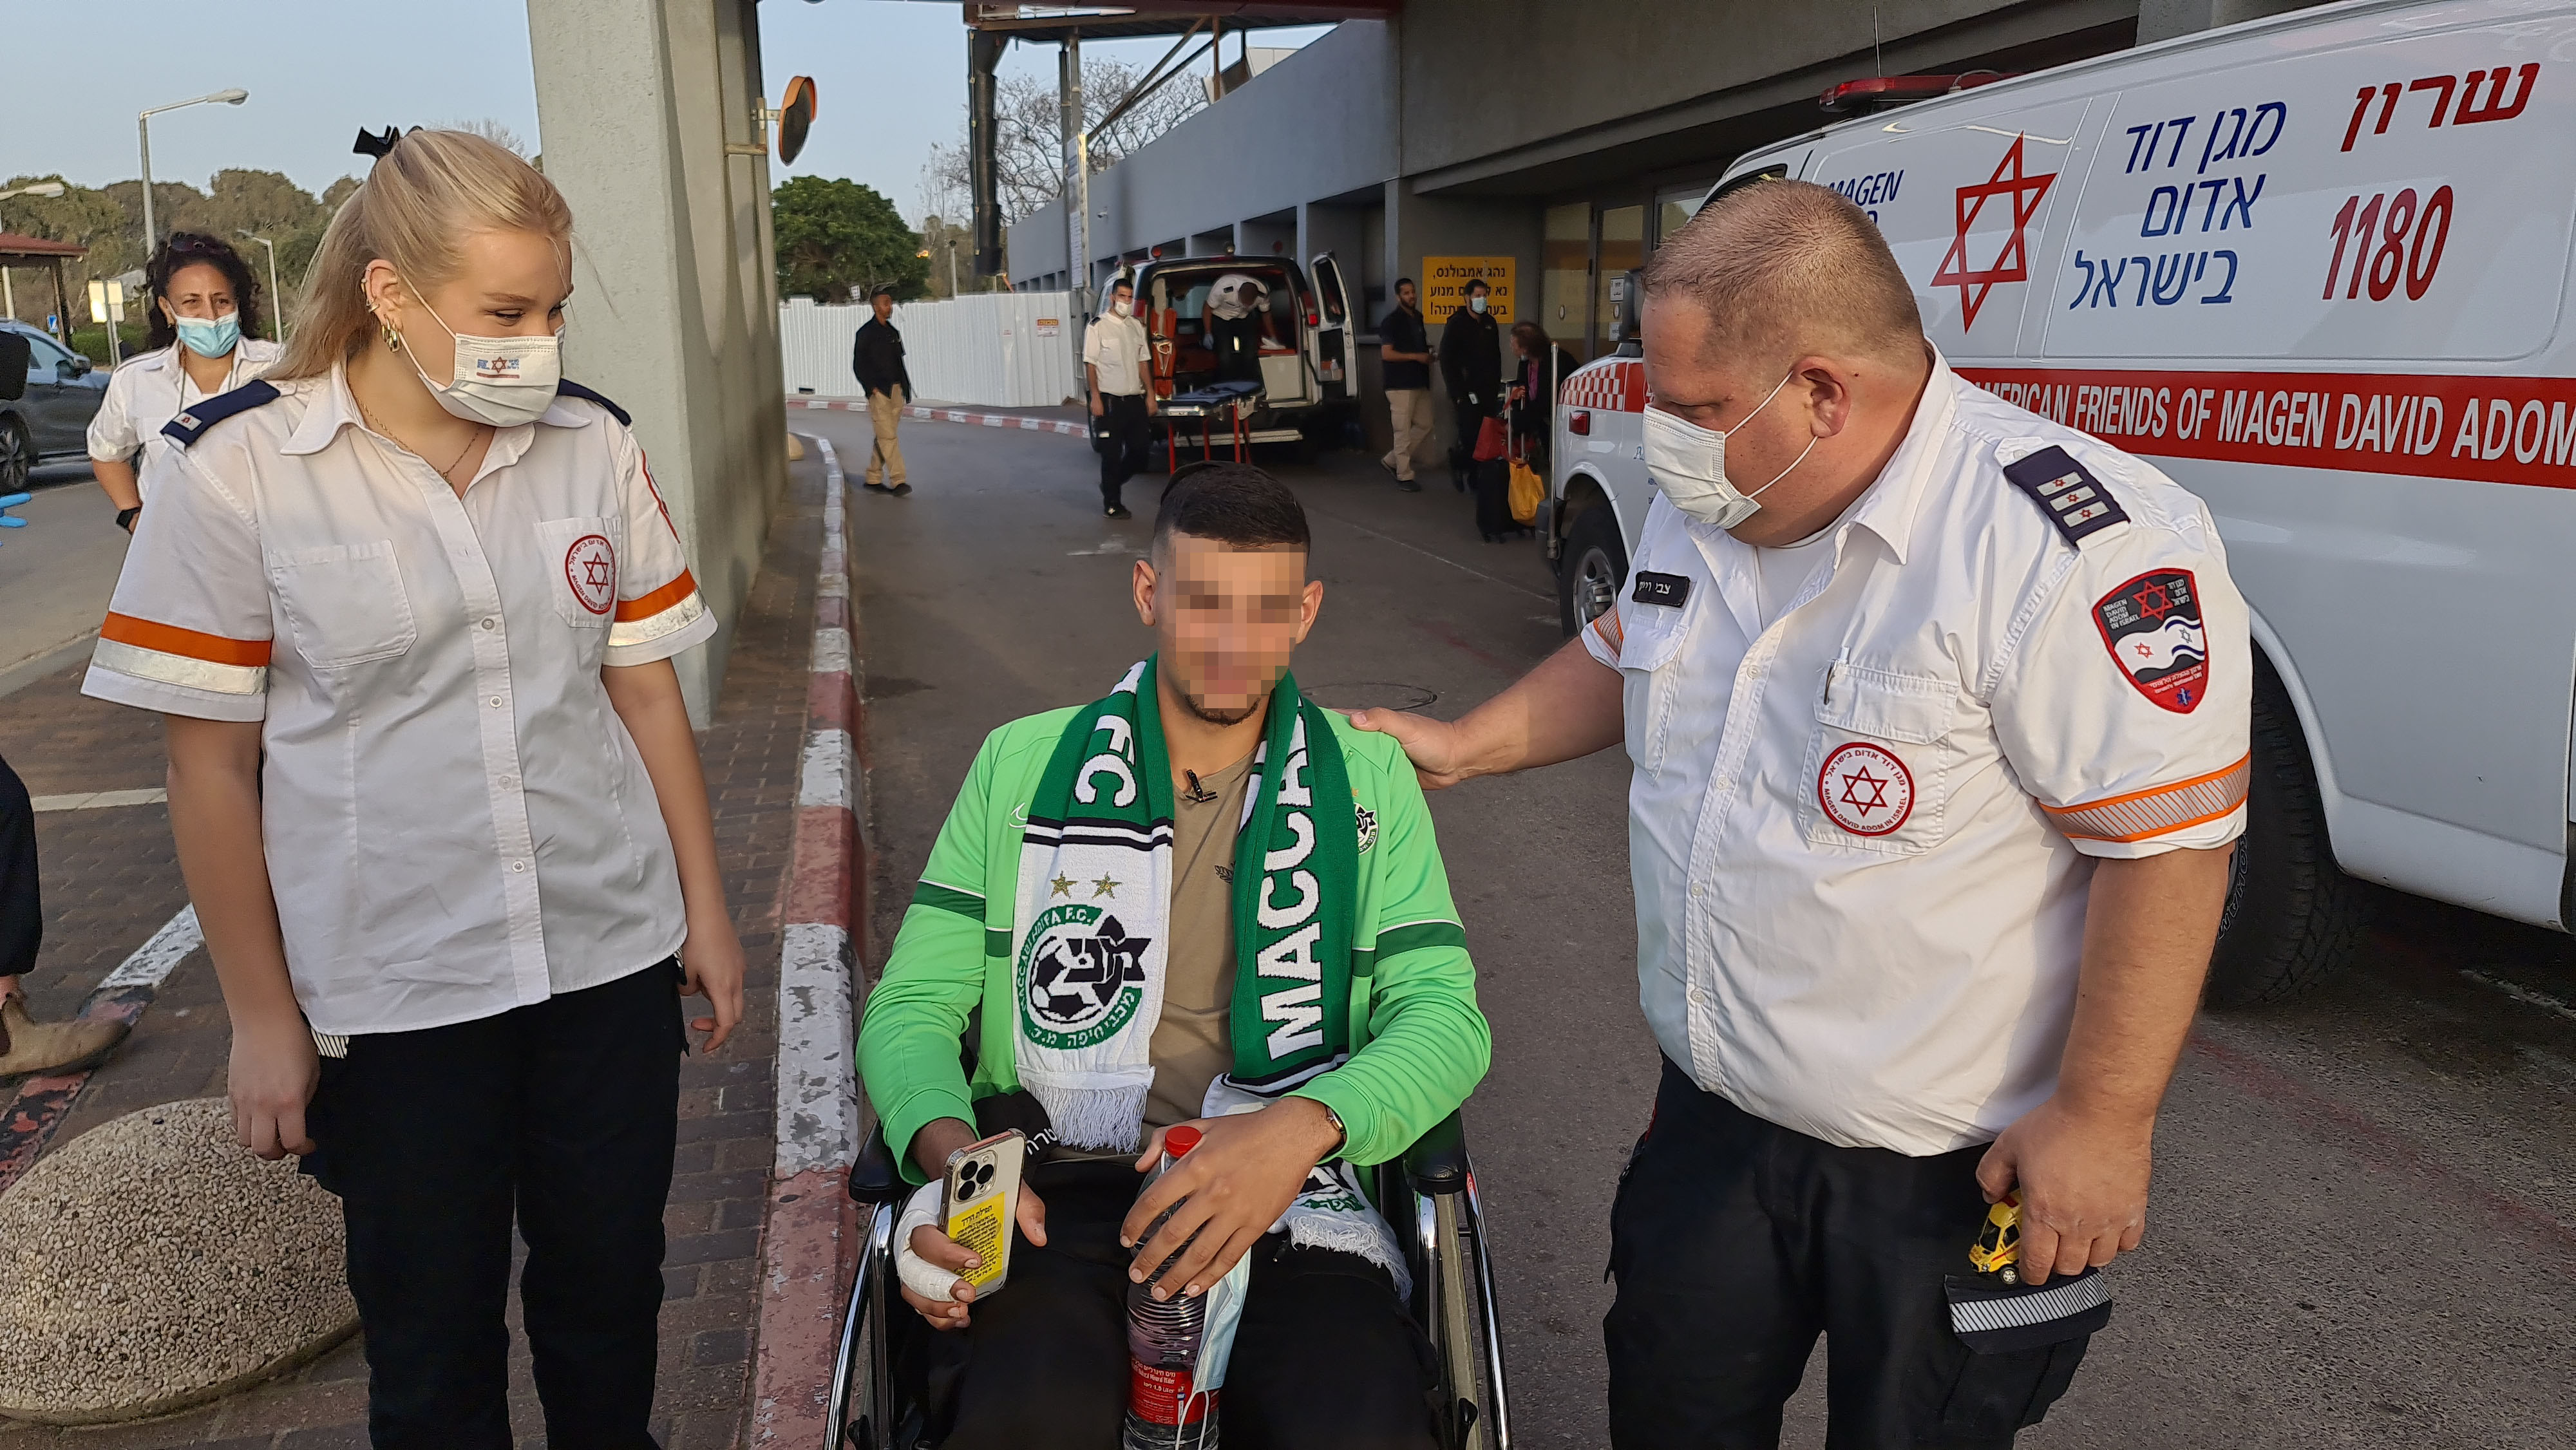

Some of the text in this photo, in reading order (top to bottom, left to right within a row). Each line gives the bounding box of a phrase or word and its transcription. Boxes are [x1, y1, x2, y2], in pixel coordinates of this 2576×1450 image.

[2340, 62, 2540, 153] שרון
[2125, 102, 2287, 174] מגן דוד
[2141, 173, 2266, 238] אדום
[1433, 264, 1506, 279] נהג אמבולנס,
[2322, 185, 2454, 302] 1180
[1430, 286, 1454, 297] מנוע
[1495, 286, 1508, 296] נא
[2069, 250, 2238, 310] בישראל
[1974, 382, 2576, 467] RICAN FRIENDS OF MAGEN DAVID ADOM
[1825, 751, 1852, 778] בישראל
[1854, 749, 1879, 760] אדום
[1824, 787, 1908, 831] MAGEN DAVID ADOM IN ISRAEL
[1256, 695, 1325, 1061] MACCA
